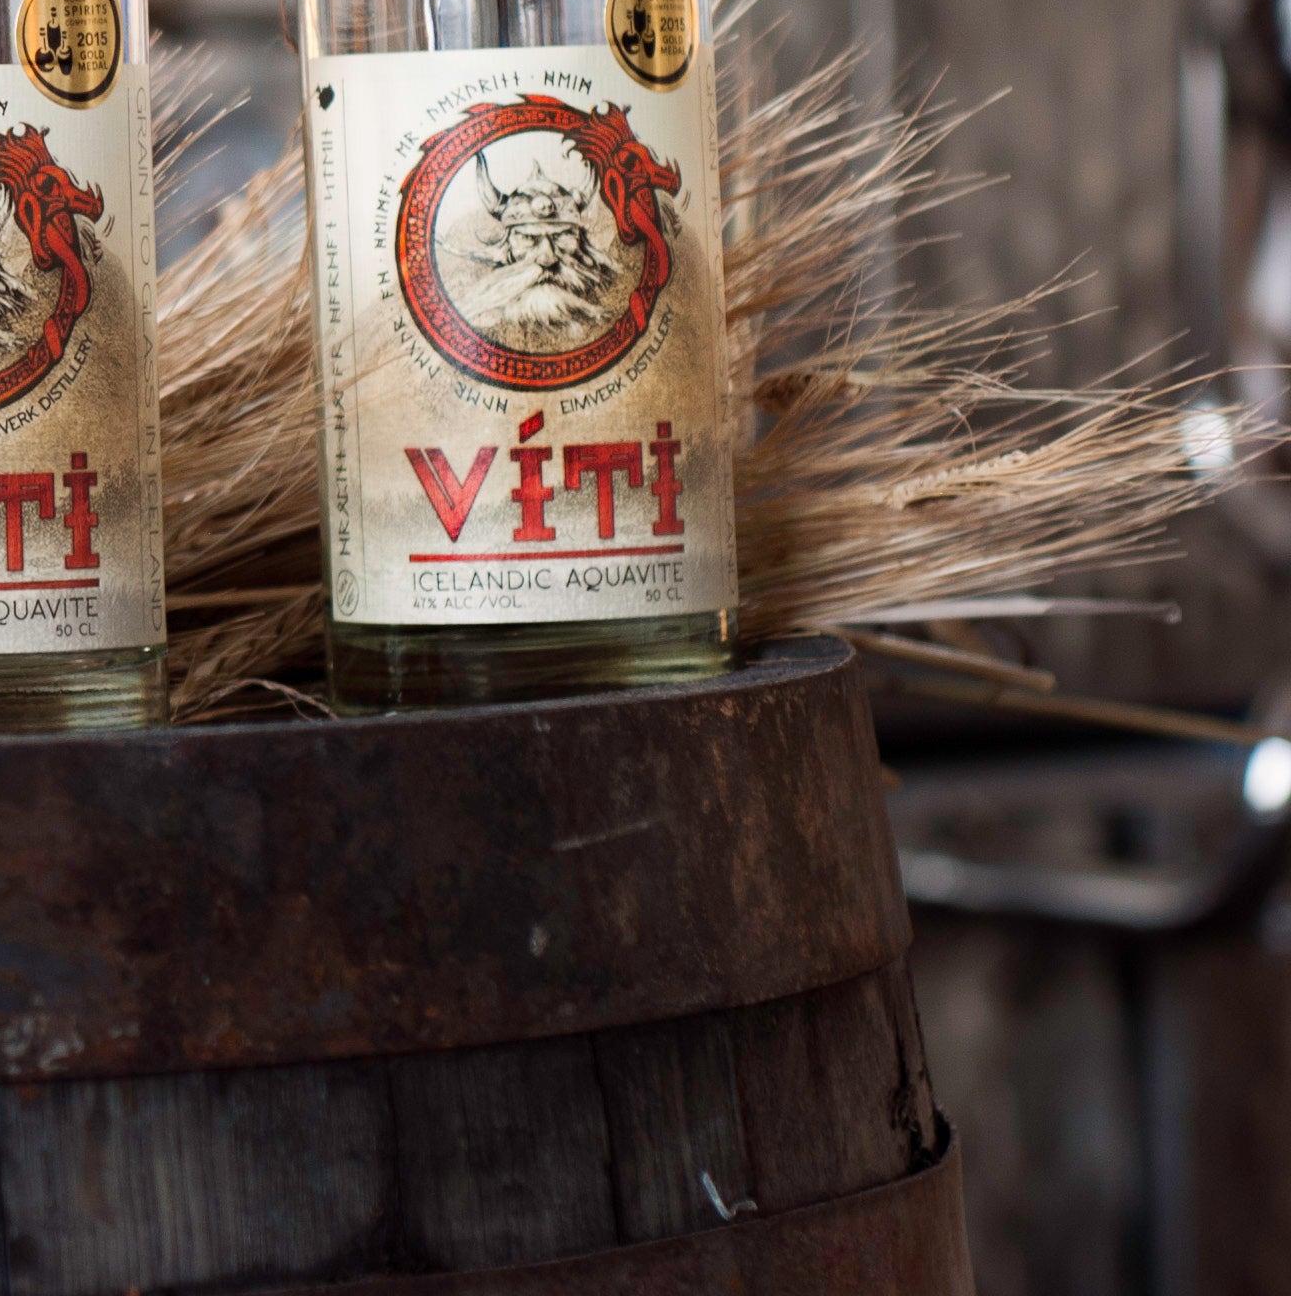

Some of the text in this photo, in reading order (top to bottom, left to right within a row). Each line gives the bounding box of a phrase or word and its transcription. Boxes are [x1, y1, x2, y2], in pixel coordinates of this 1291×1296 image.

[64, 4, 107, 16] SPIRITS
[660, 17, 685, 32] 2015
[77, 32, 108, 47] 2015
[663, 35, 683, 44] GOLD
[80, 50, 105, 60] GOLD
[79, 61, 108, 71] MEDAL
[136, 87, 149, 196] GRAIN
[140, 215, 151, 265] TO
[141, 282, 155, 408] GLASS
[560, 304, 675, 414] EIMVERK DISTILLERY
[38, 332, 93, 411] DISTILLERY
[146, 425, 157, 455] IN
[413, 562, 684, 592] ICELANDIC AQUAVITE
[413, 596, 437, 610] 47%
[645, 589, 661, 602] 50
[55, 624, 73, 637] 50
